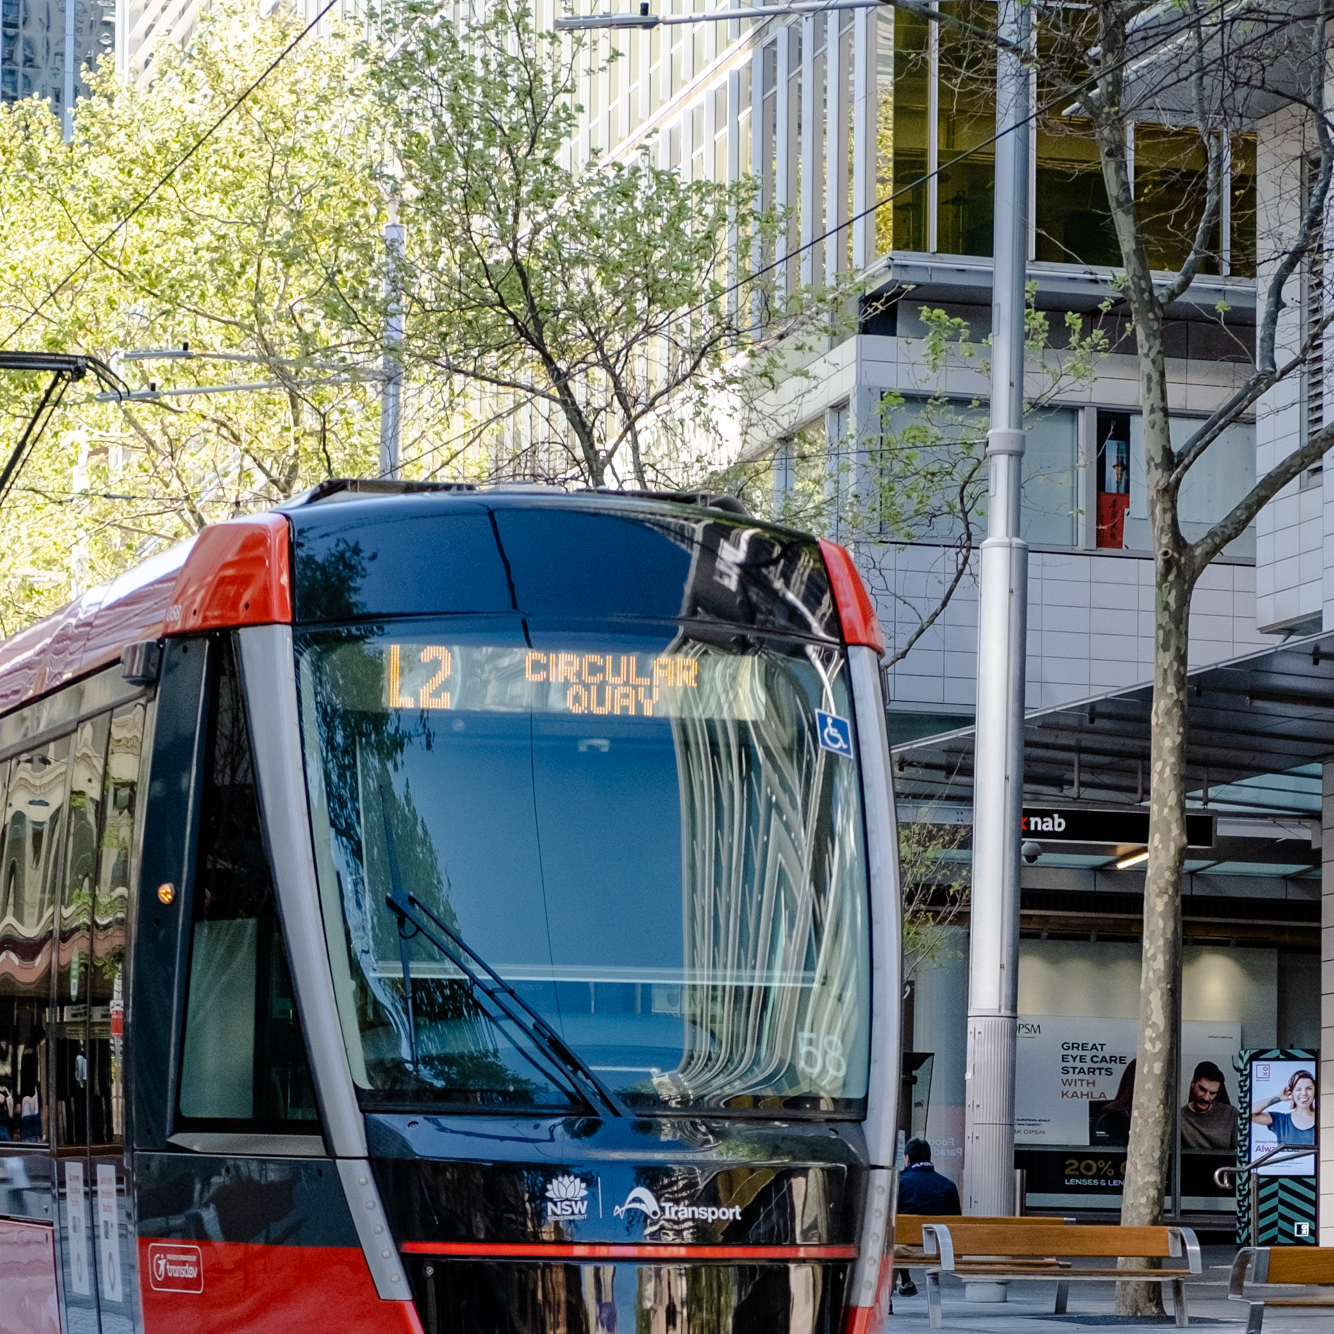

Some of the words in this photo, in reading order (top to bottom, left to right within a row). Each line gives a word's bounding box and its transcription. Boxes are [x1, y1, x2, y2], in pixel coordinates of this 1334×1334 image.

[389, 644, 451, 709] L2
[525, 652, 698, 687] CIRCULAR
[566, 684, 659, 716] QUAY
[1029, 813, 1066, 832] nab
[1017, 1023, 1041, 1034] PSM
[1061, 1041, 1106, 1052] GREAT
[797, 1032, 846, 1079] 58
[1061, 1054, 1088, 1064] EYE
[1090, 1055, 1127, 1065] CARE
[1061, 1066, 1114, 1076] STARTS
[1061, 1078, 1096, 1087] WITH
[1061, 1090, 1107, 1100] KAHLA
[1064, 1159, 1115, 1176] 20%
[1064, 1178, 1099, 1186] LENSES
[547, 1200, 588, 1215] NSW
[660, 1202, 742, 1222] Transport
[547, 1214, 588, 1222] GOVERNMENT
